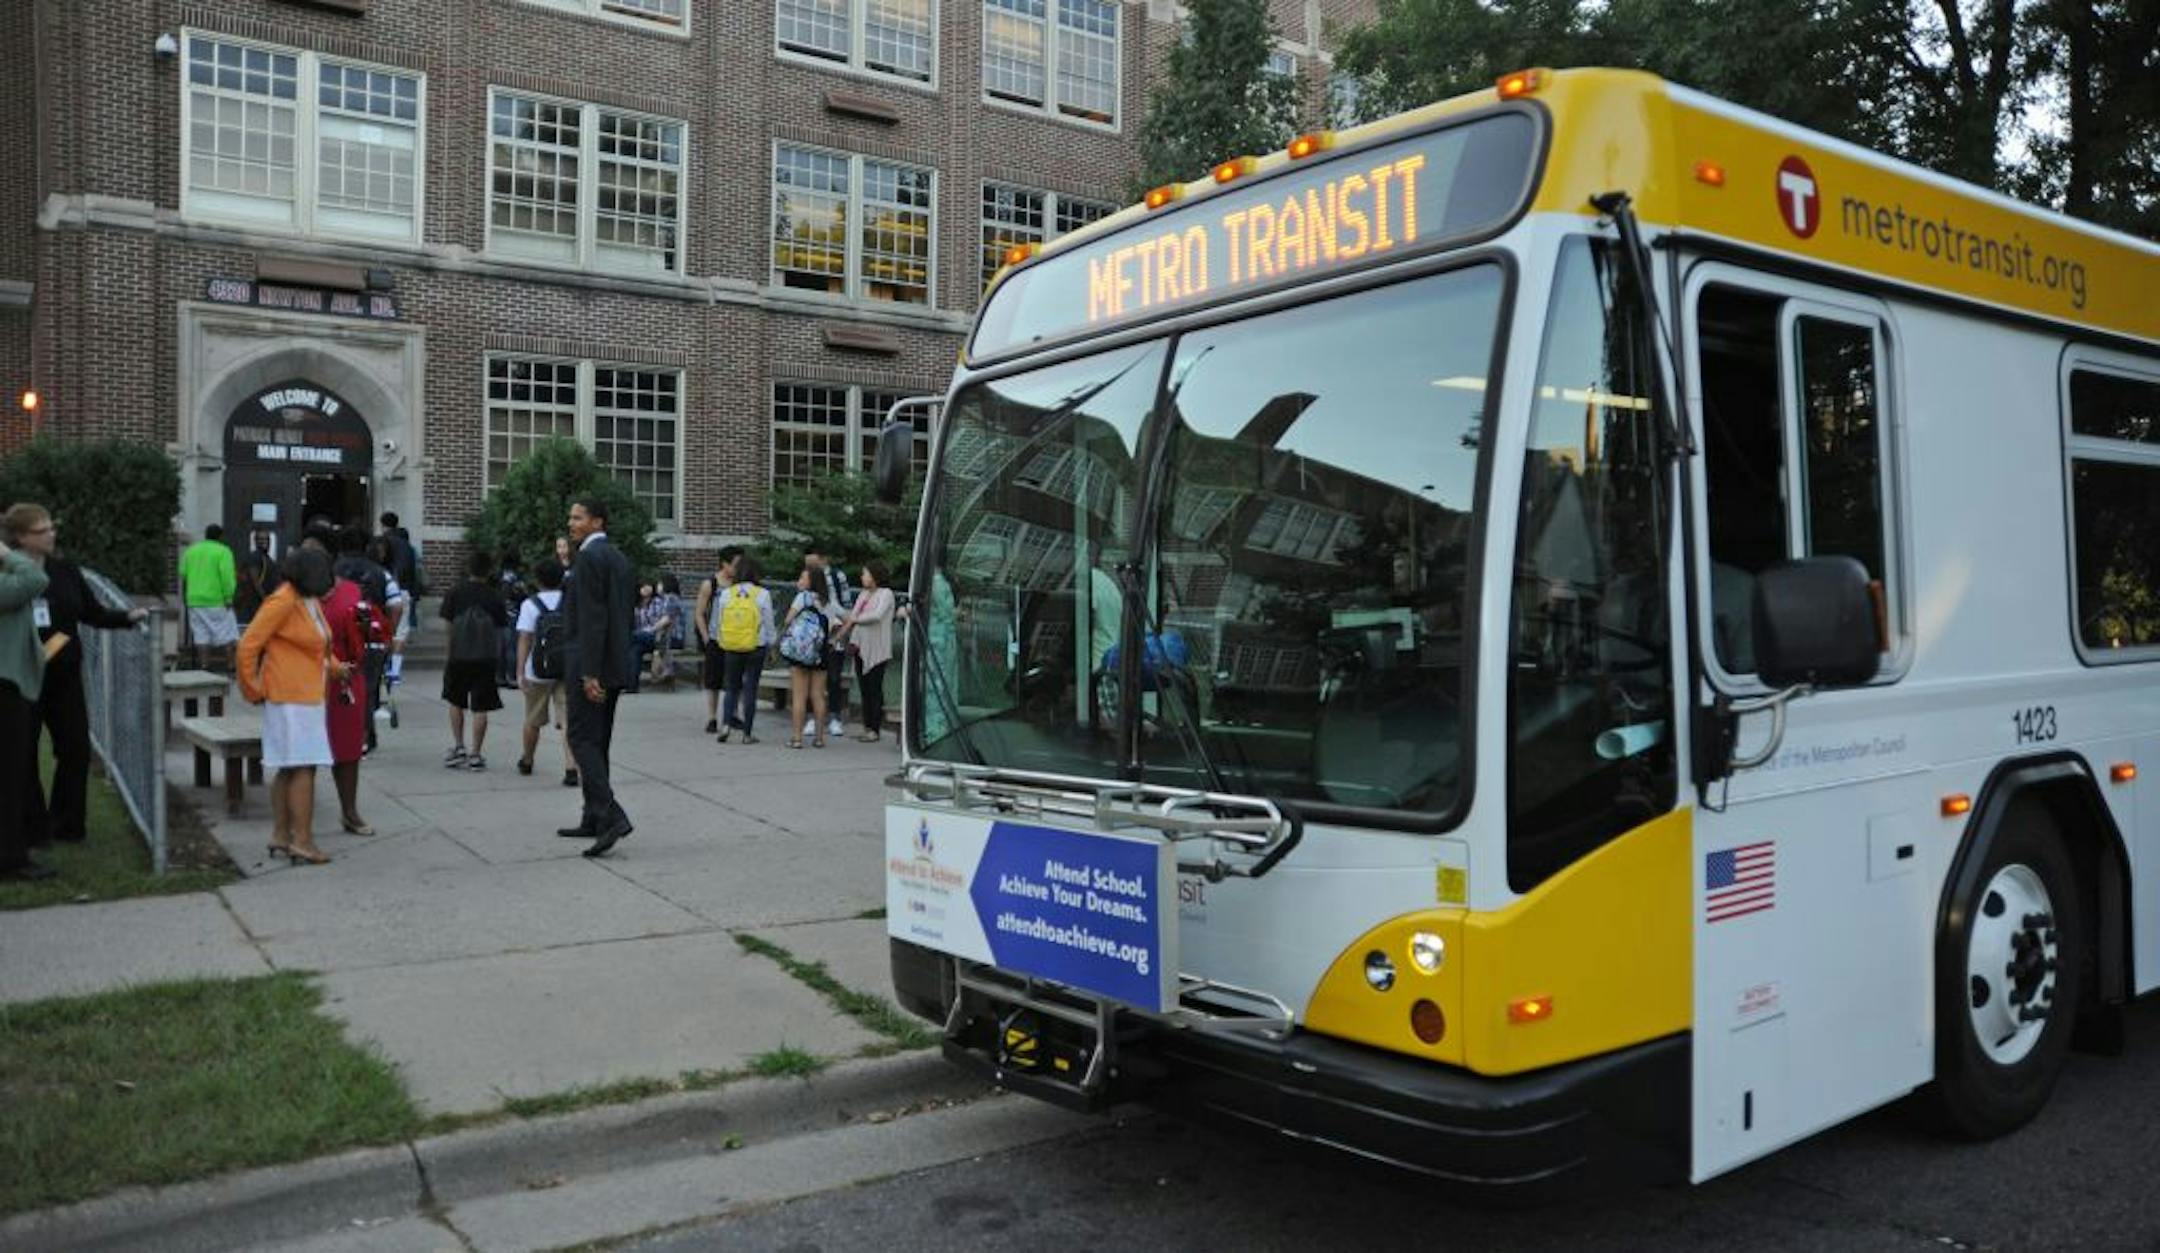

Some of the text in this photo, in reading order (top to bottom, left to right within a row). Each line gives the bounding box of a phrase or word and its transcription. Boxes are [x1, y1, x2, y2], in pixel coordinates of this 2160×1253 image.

[1223, 153, 1426, 284] TRANSIT
[1841, 196, 2087, 310] metrotransit.org
[259, 388, 340, 417] WELCOME TO
[257, 443, 343, 463] MAIN ENTRANCE
[2012, 706, 2057, 744] 1423
[999, 875, 1049, 901] Achieve
[1051, 884, 1083, 909] Your
[1086, 892, 1148, 923] Dreams.
[1044, 859, 1147, 899] Attend School.
[996, 913, 1149, 975] attendtoachieve.org
